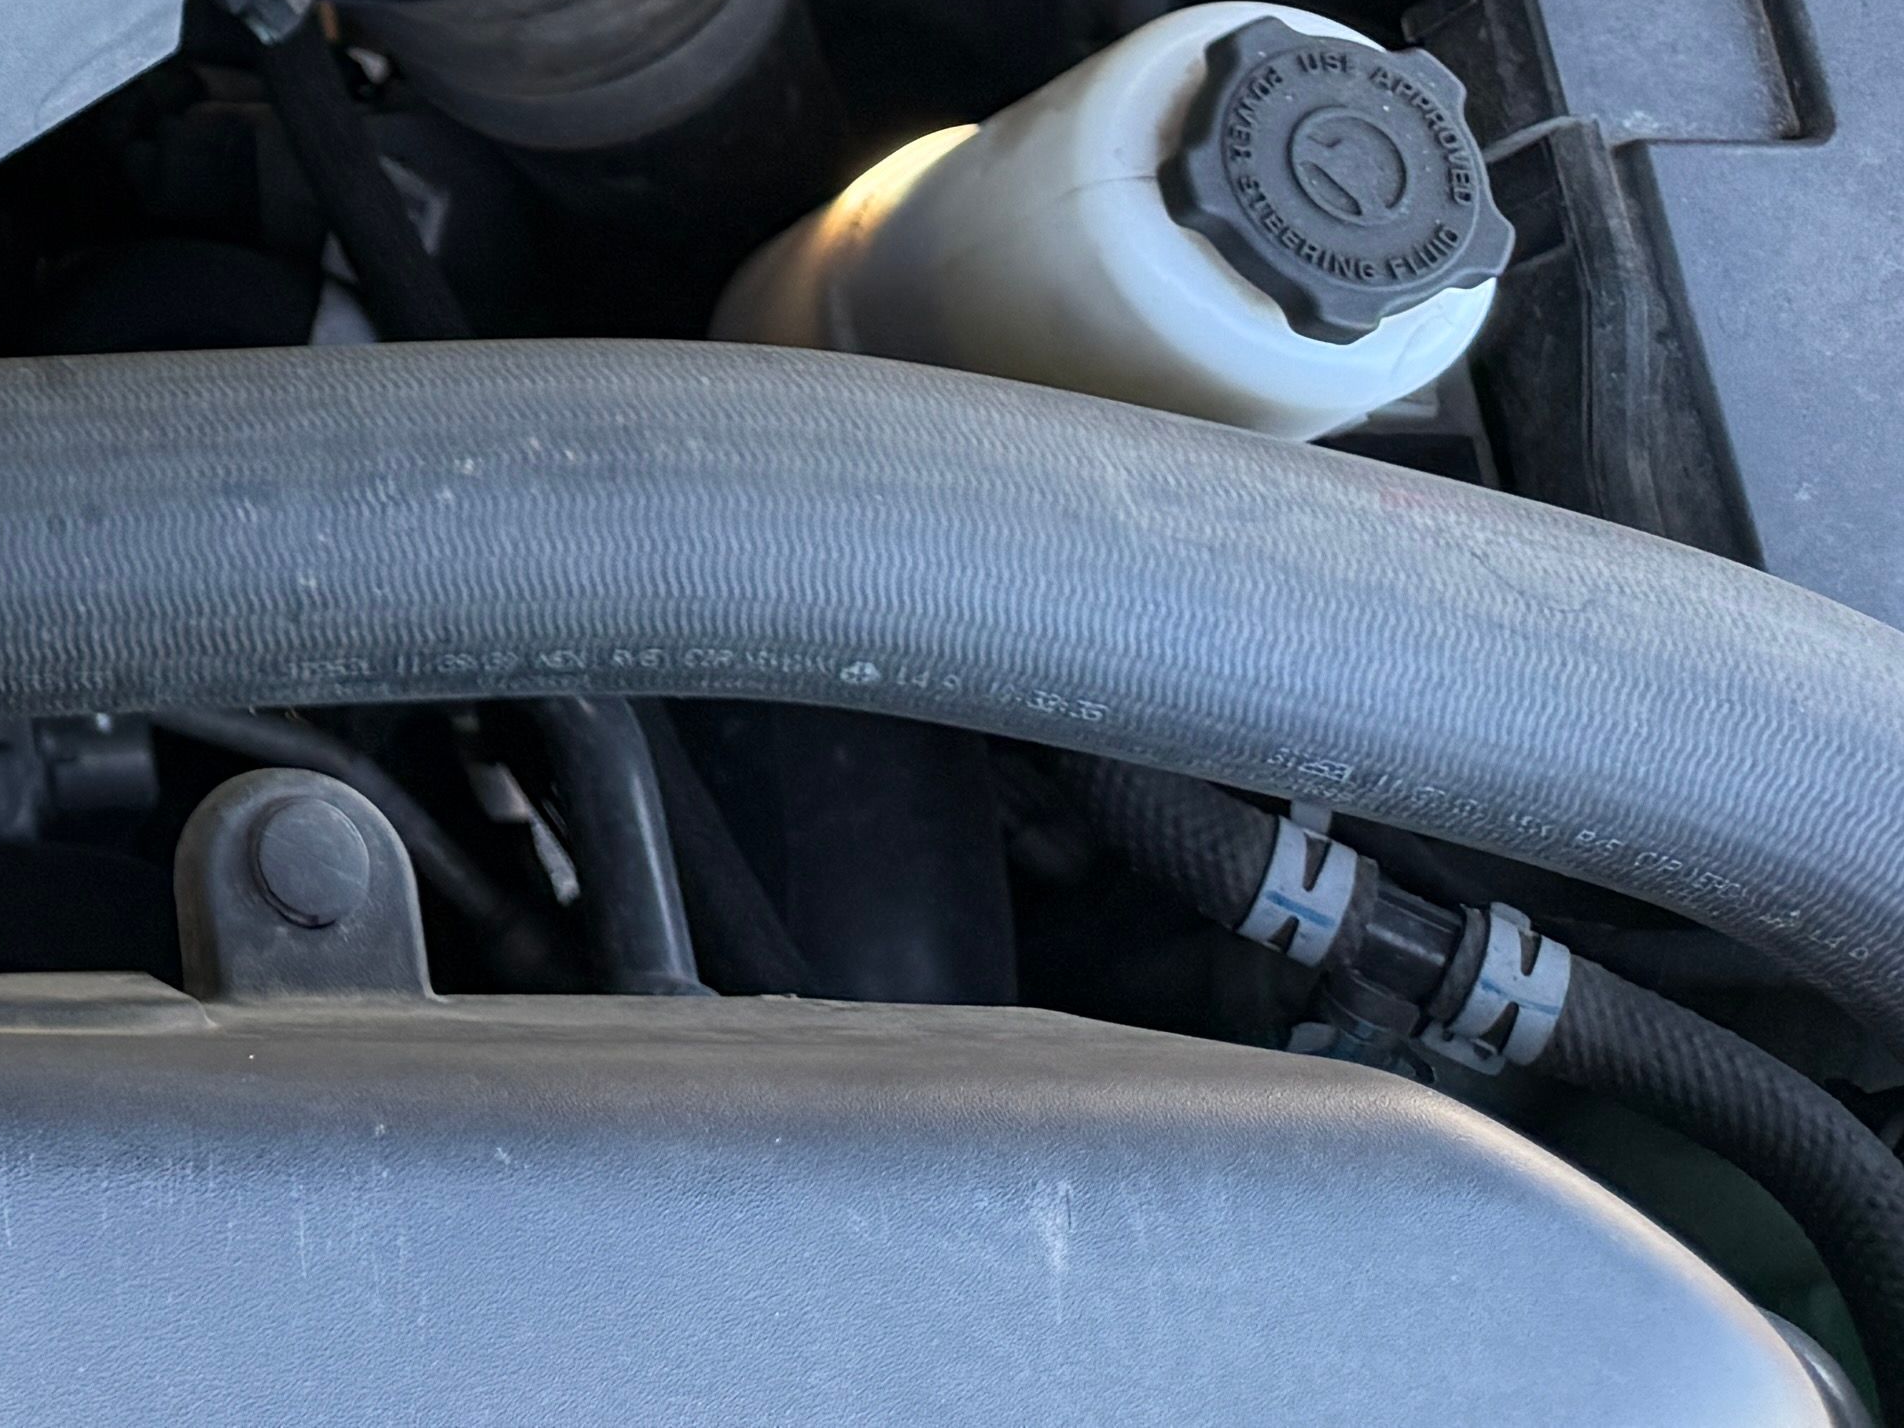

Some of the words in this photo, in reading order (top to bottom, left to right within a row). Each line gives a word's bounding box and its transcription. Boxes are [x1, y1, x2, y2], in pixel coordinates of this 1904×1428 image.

[1296, 52, 1353, 74] USE
[1368, 64, 1474, 208] APPROVED
[1238, 175, 1379, 281] STEERING
[1385, 226, 1460, 281] FLUID
